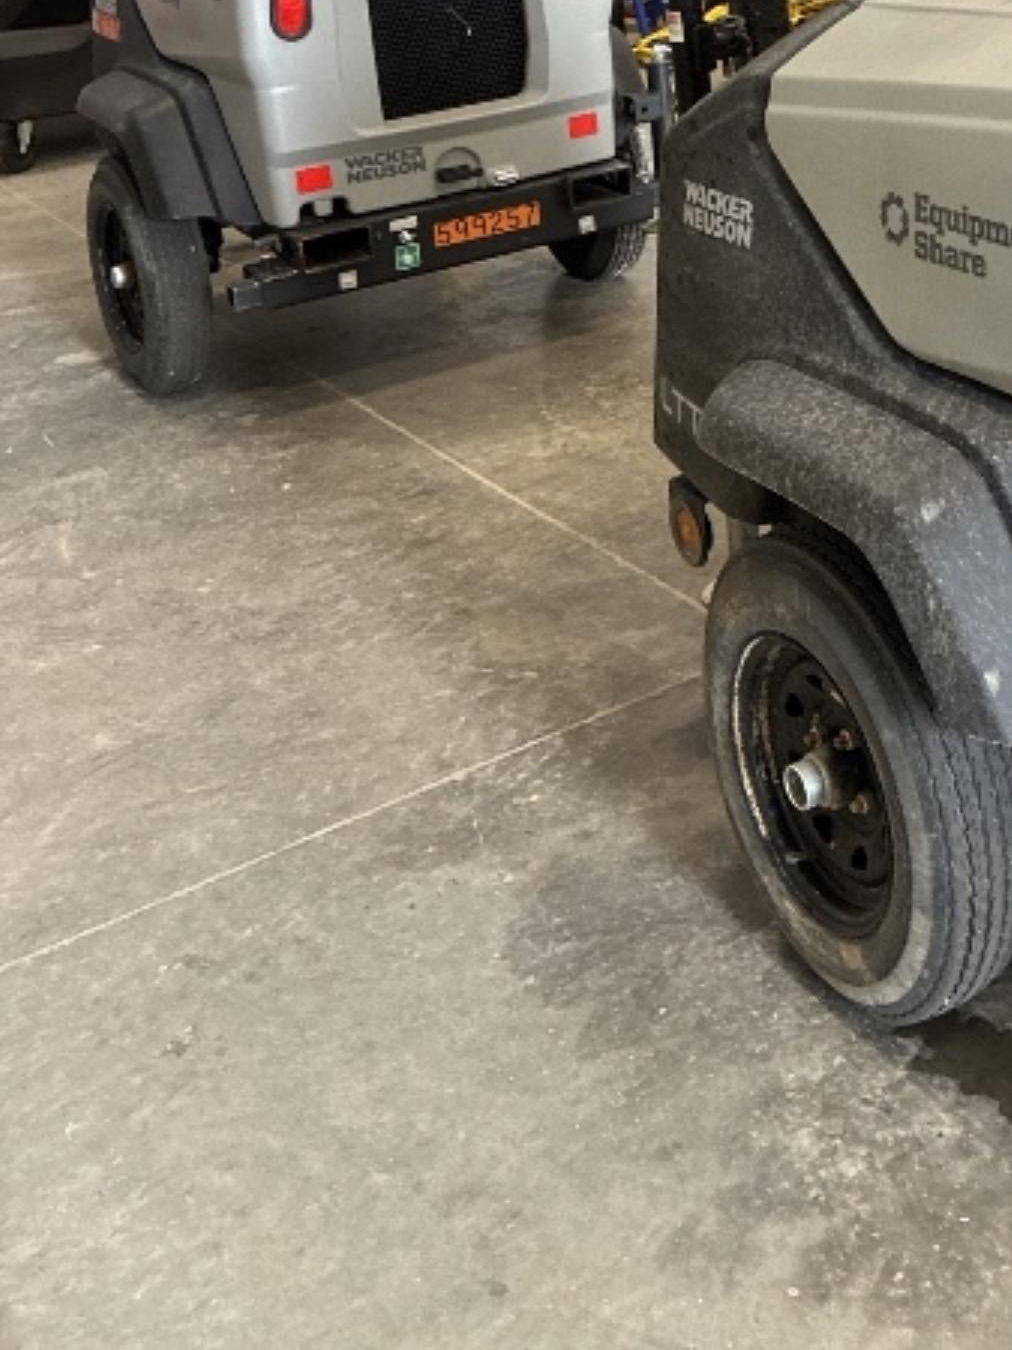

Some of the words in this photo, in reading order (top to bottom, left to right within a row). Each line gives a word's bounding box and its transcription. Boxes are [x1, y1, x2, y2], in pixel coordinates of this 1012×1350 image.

[344, 146, 423, 169] WACKER
[347, 158, 426, 185] NEUSON
[683, 178, 754, 225] WACKER
[436, 203, 535, 245] 599257
[683, 201, 754, 250] NEUSON
[913, 229, 988, 280] Share
